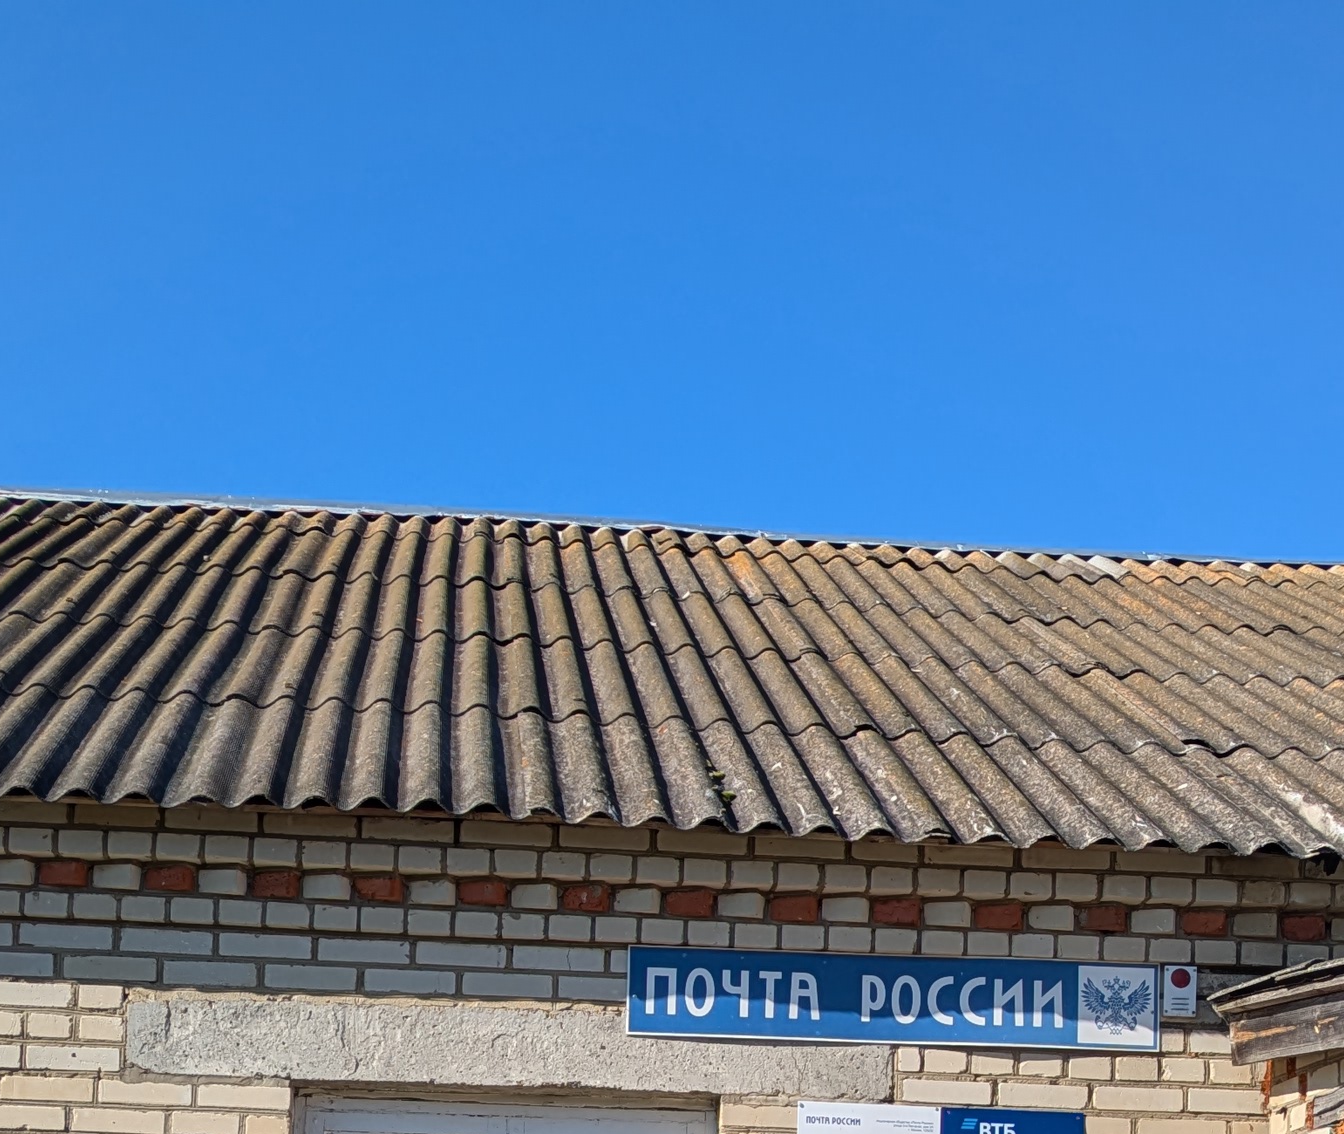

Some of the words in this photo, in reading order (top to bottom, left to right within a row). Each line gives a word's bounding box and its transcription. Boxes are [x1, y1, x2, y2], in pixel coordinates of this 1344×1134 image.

[645, 966, 820, 1021] ПОЧТА
[860, 974, 1063, 1028] РОССИИ
[806, 1116, 829, 1124] ПОЧТА
[832, 1117, 861, 1126] РОССИИ
